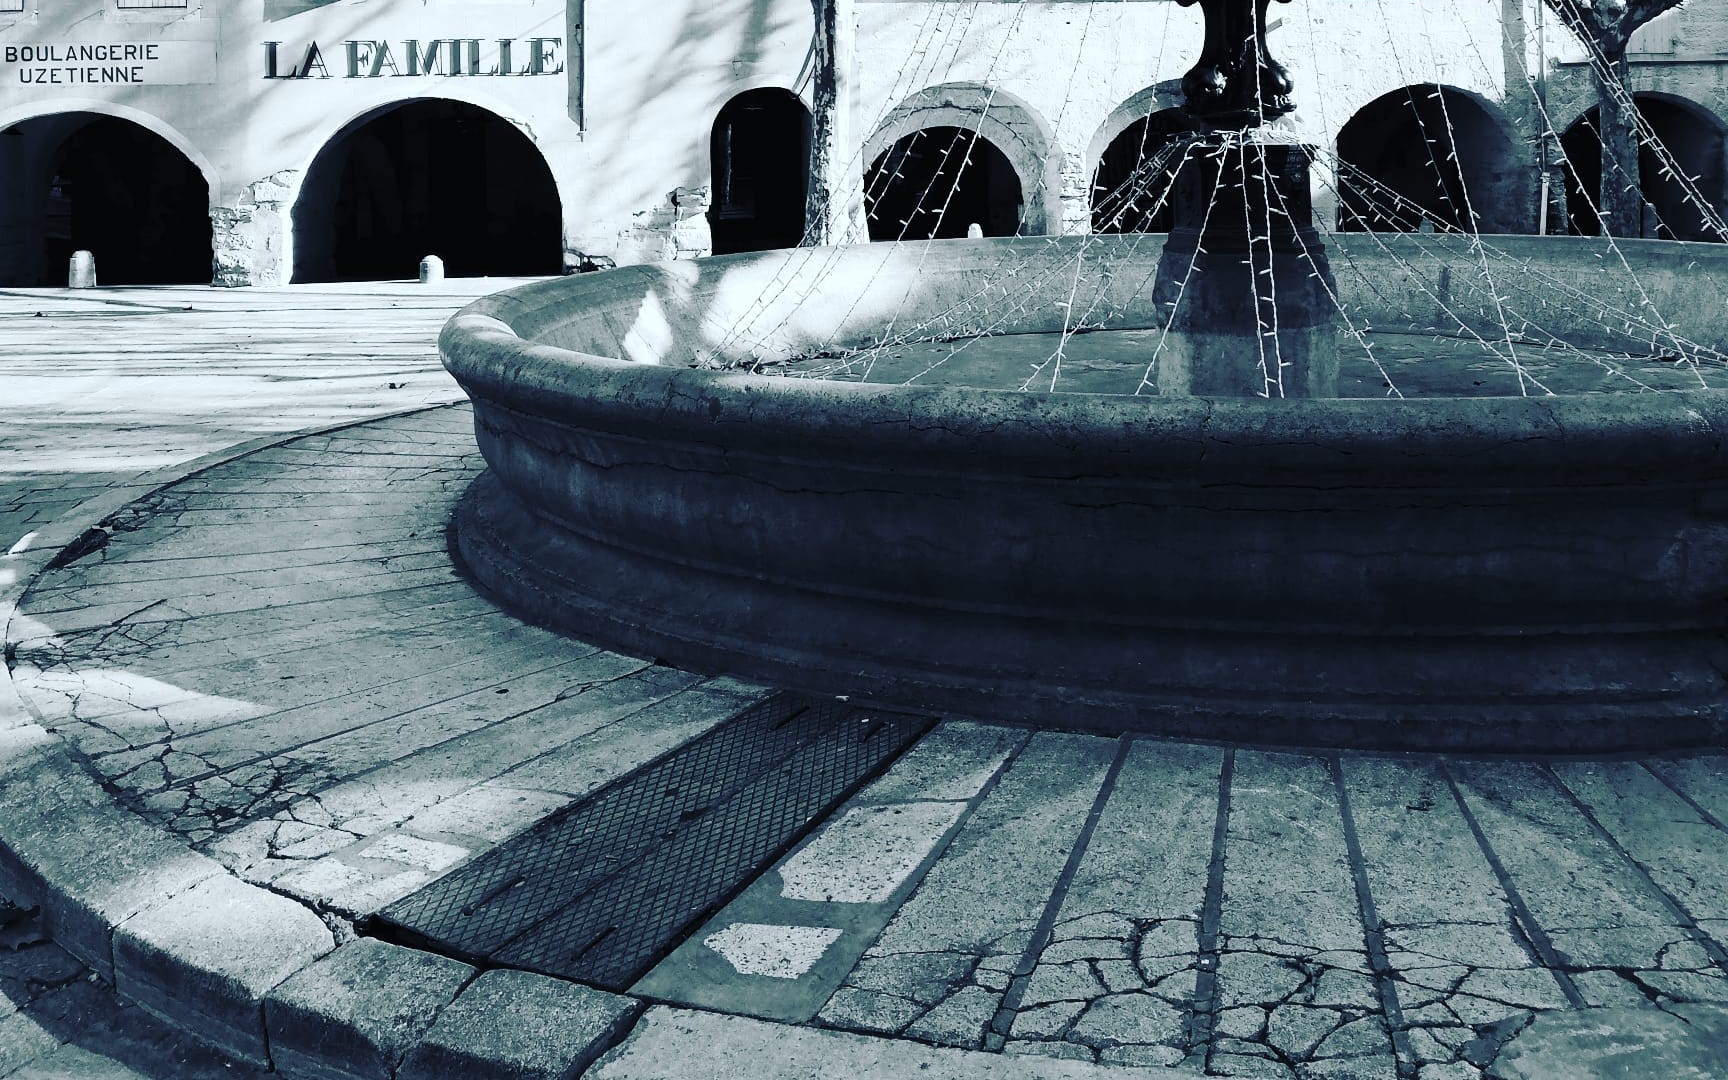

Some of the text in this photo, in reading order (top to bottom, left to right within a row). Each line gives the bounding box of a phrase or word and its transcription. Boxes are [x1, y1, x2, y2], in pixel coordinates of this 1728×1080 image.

[5, 44, 159, 62] BOULANGERIE
[261, 37, 563, 79] LA FAMILLE
[20, 67, 144, 83] UZETIENNE
